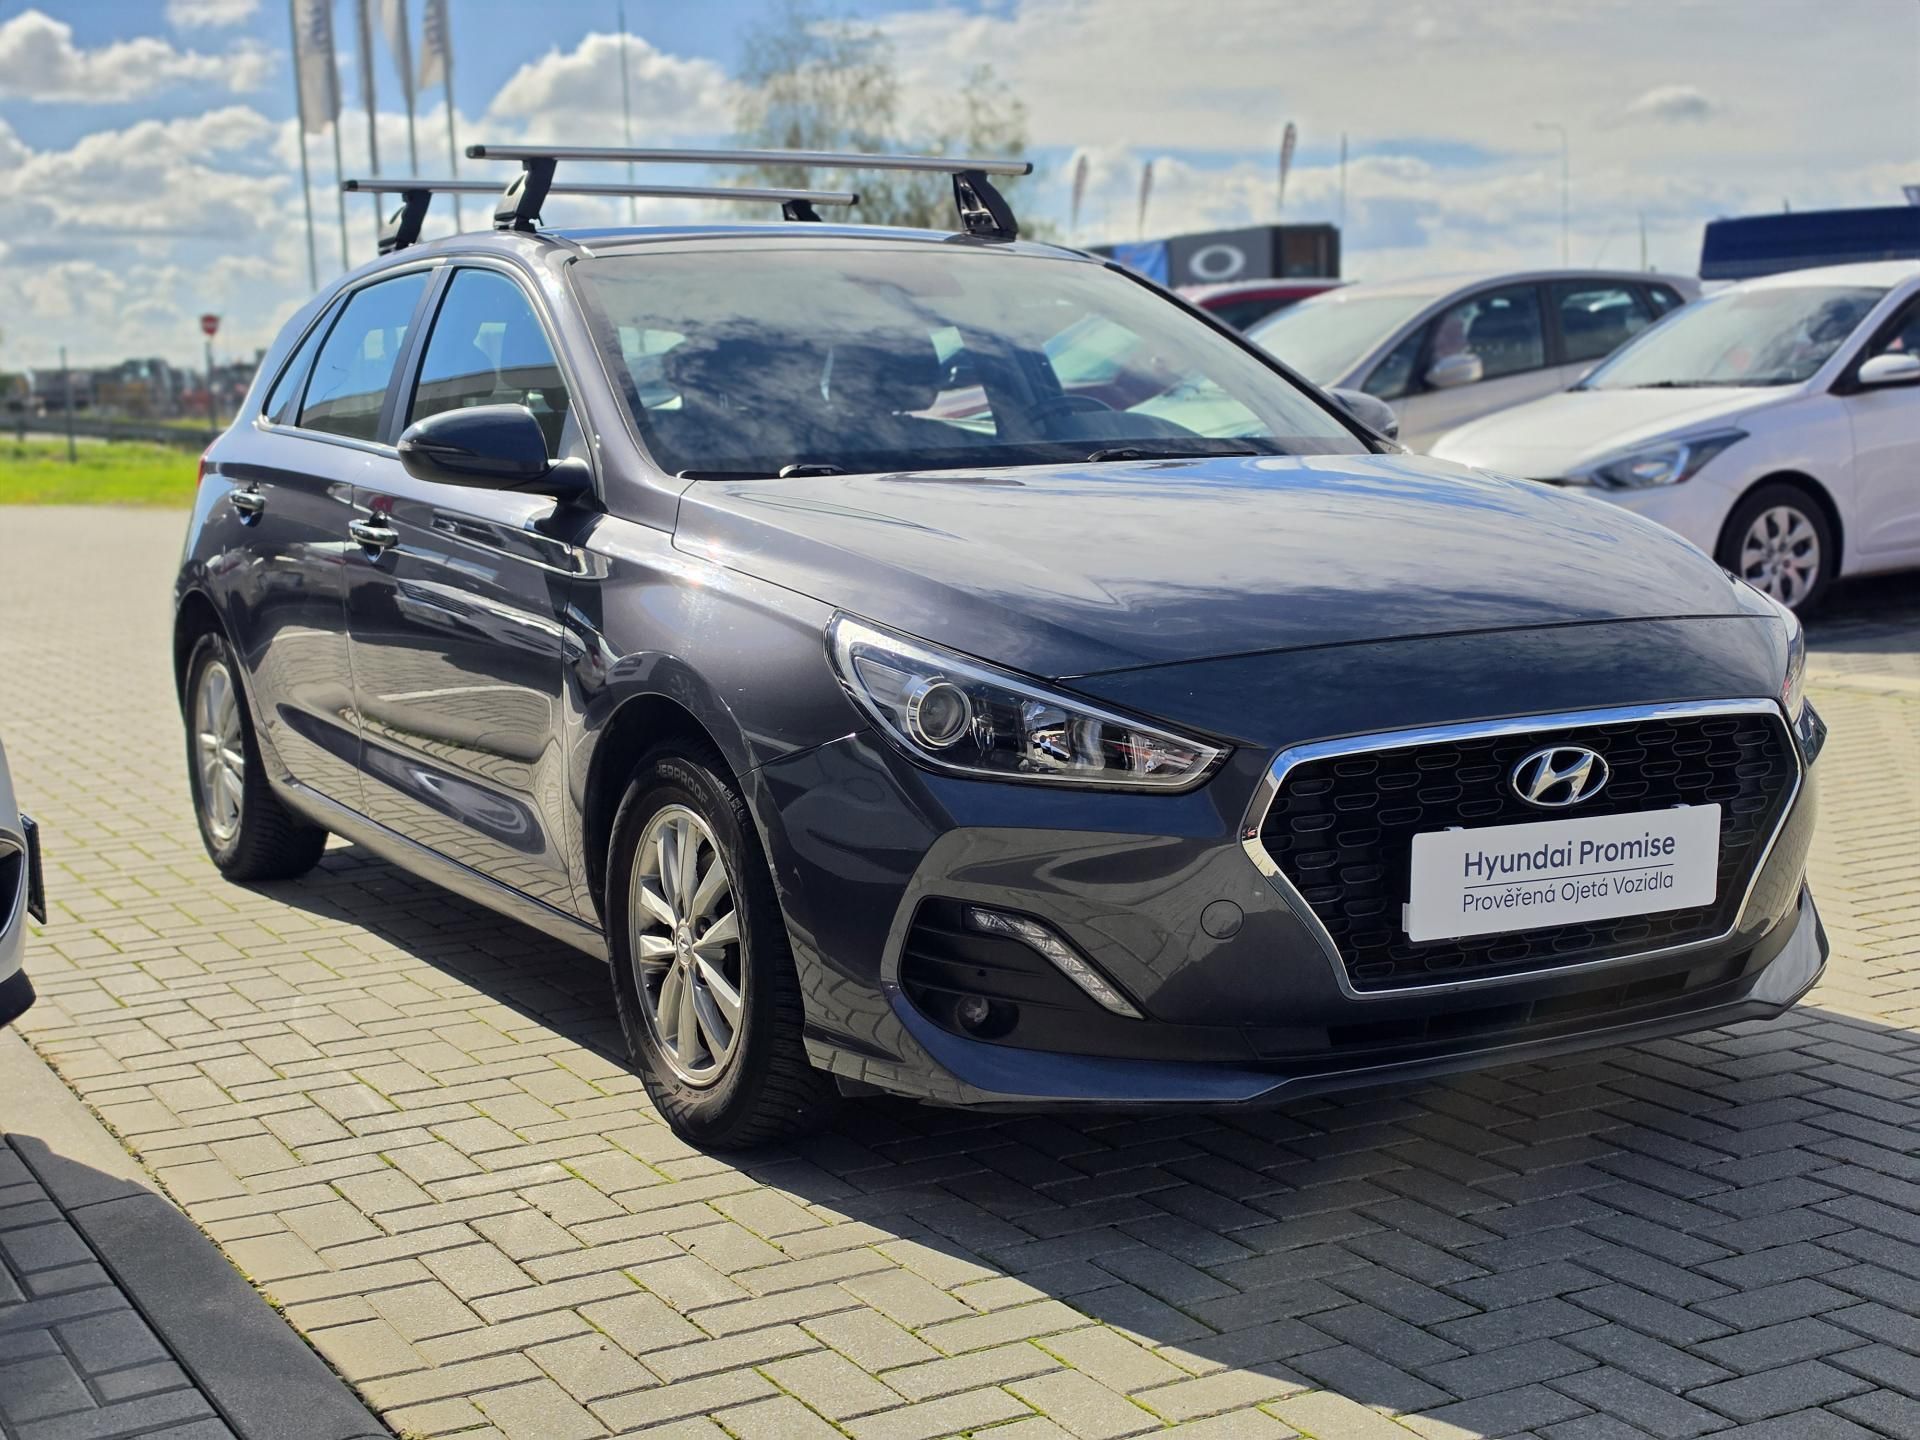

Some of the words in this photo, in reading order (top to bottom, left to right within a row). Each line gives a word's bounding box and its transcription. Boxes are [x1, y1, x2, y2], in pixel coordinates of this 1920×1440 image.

[1464, 841, 1572, 880] Hyundai
[1579, 832, 1675, 865] Promise
[1463, 884, 1555, 912] Prověřená
[1561, 877, 1608, 903] Ojetá
[1613, 871, 1674, 895] Vozidla
